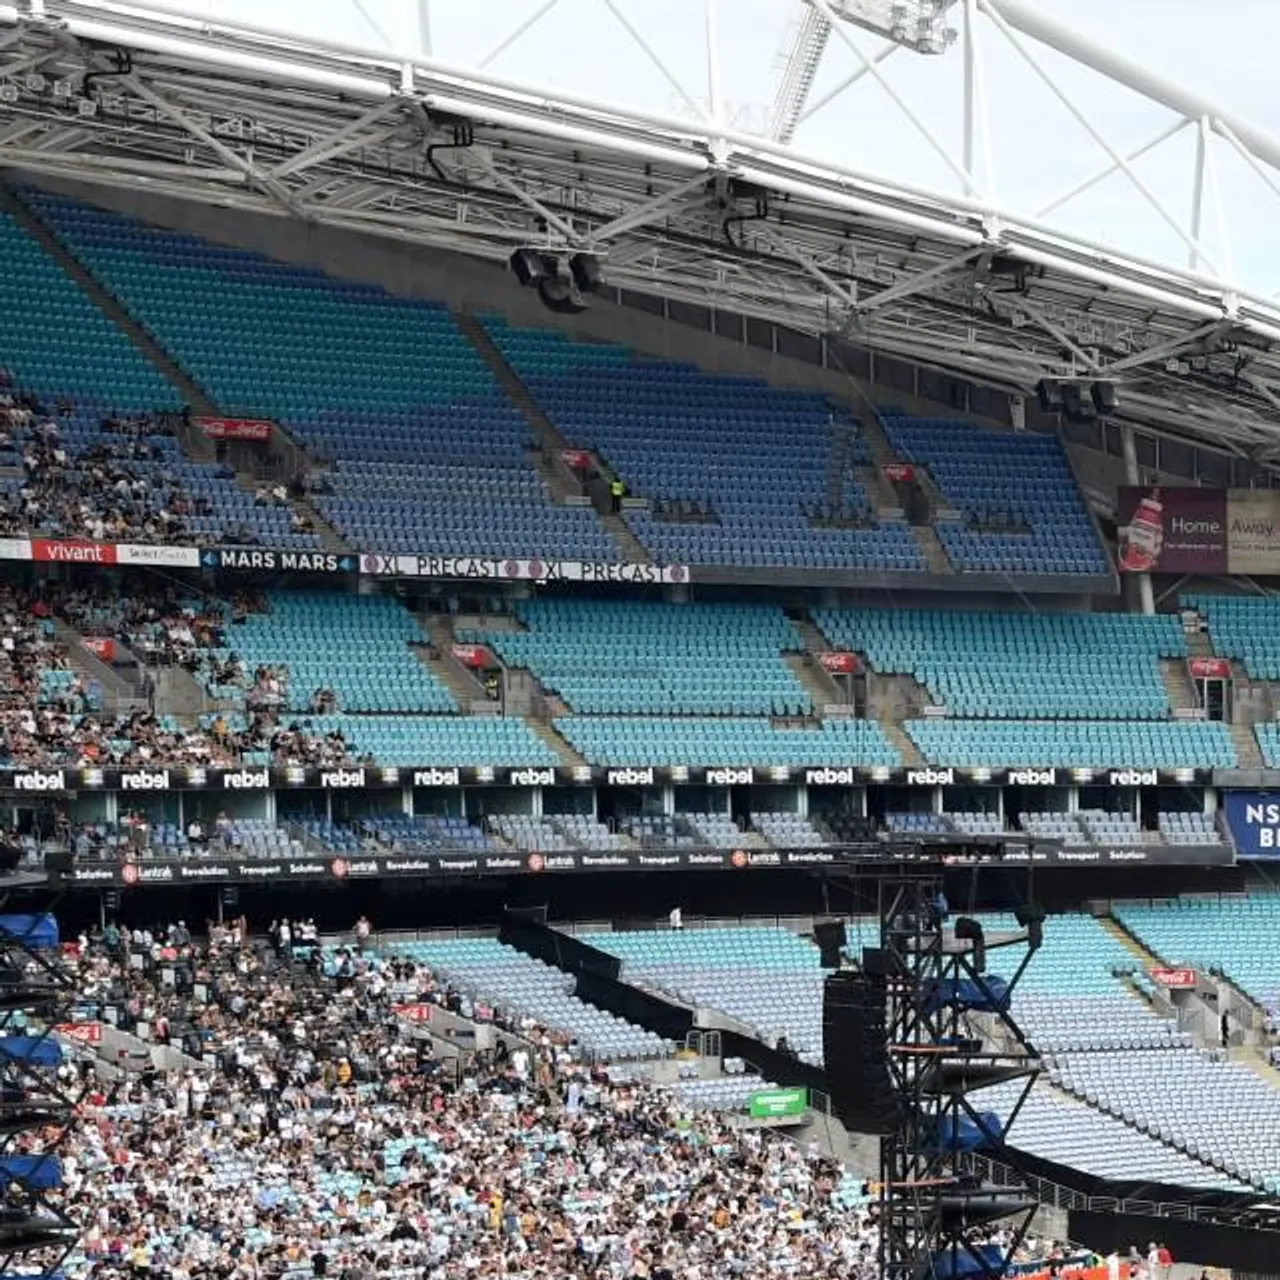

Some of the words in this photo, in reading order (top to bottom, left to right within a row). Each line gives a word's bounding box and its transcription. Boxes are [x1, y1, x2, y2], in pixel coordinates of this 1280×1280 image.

[221, 551, 275, 568] MARS
[282, 553, 337, 571] MARS
[382, 556, 405, 574] XL
[417, 556, 500, 576] PRECAST
[581, 561, 666, 582] PRECAST
[14, 770, 65, 789] rebel
[122, 770, 169, 789] rebel
[224, 769, 269, 788] rebel
[322, 769, 365, 787] rebel
[414, 768, 459, 785] rebel
[511, 768, 554, 785] rebel
[608, 768, 653, 785] rebel
[706, 768, 753, 785] rebel
[806, 767, 853, 785] rebel
[907, 767, 953, 785] rebel
[1009, 767, 1055, 785] rebel
[1110, 767, 1157, 785] rebel
